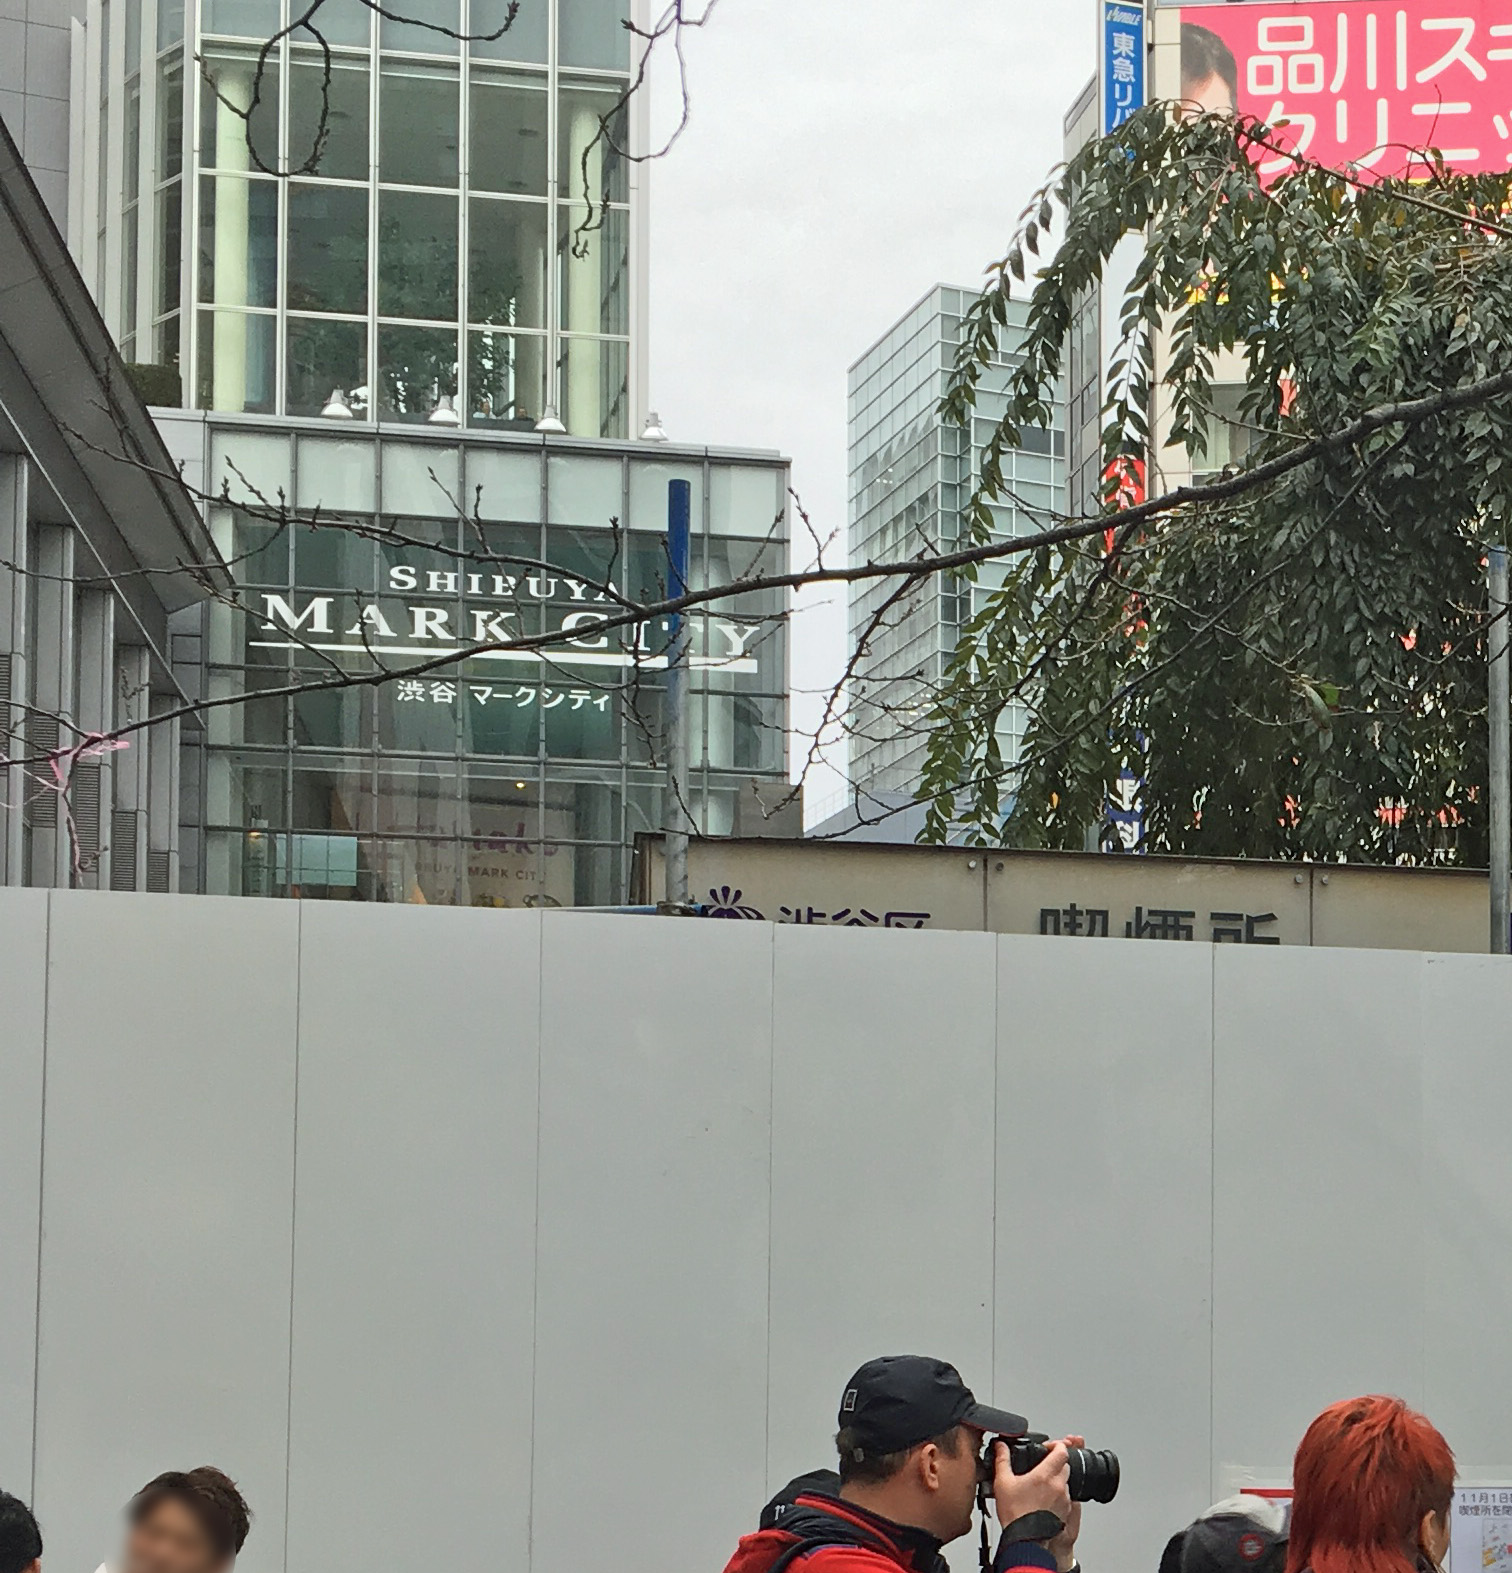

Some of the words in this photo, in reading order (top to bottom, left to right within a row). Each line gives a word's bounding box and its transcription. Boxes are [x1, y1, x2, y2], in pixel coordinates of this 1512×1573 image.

[389, 565, 620, 603] SHIBUYA
[260, 594, 517, 643] MARK
[396, 680, 458, 704] 渋谷
[469, 686, 612, 713] マークシティ
